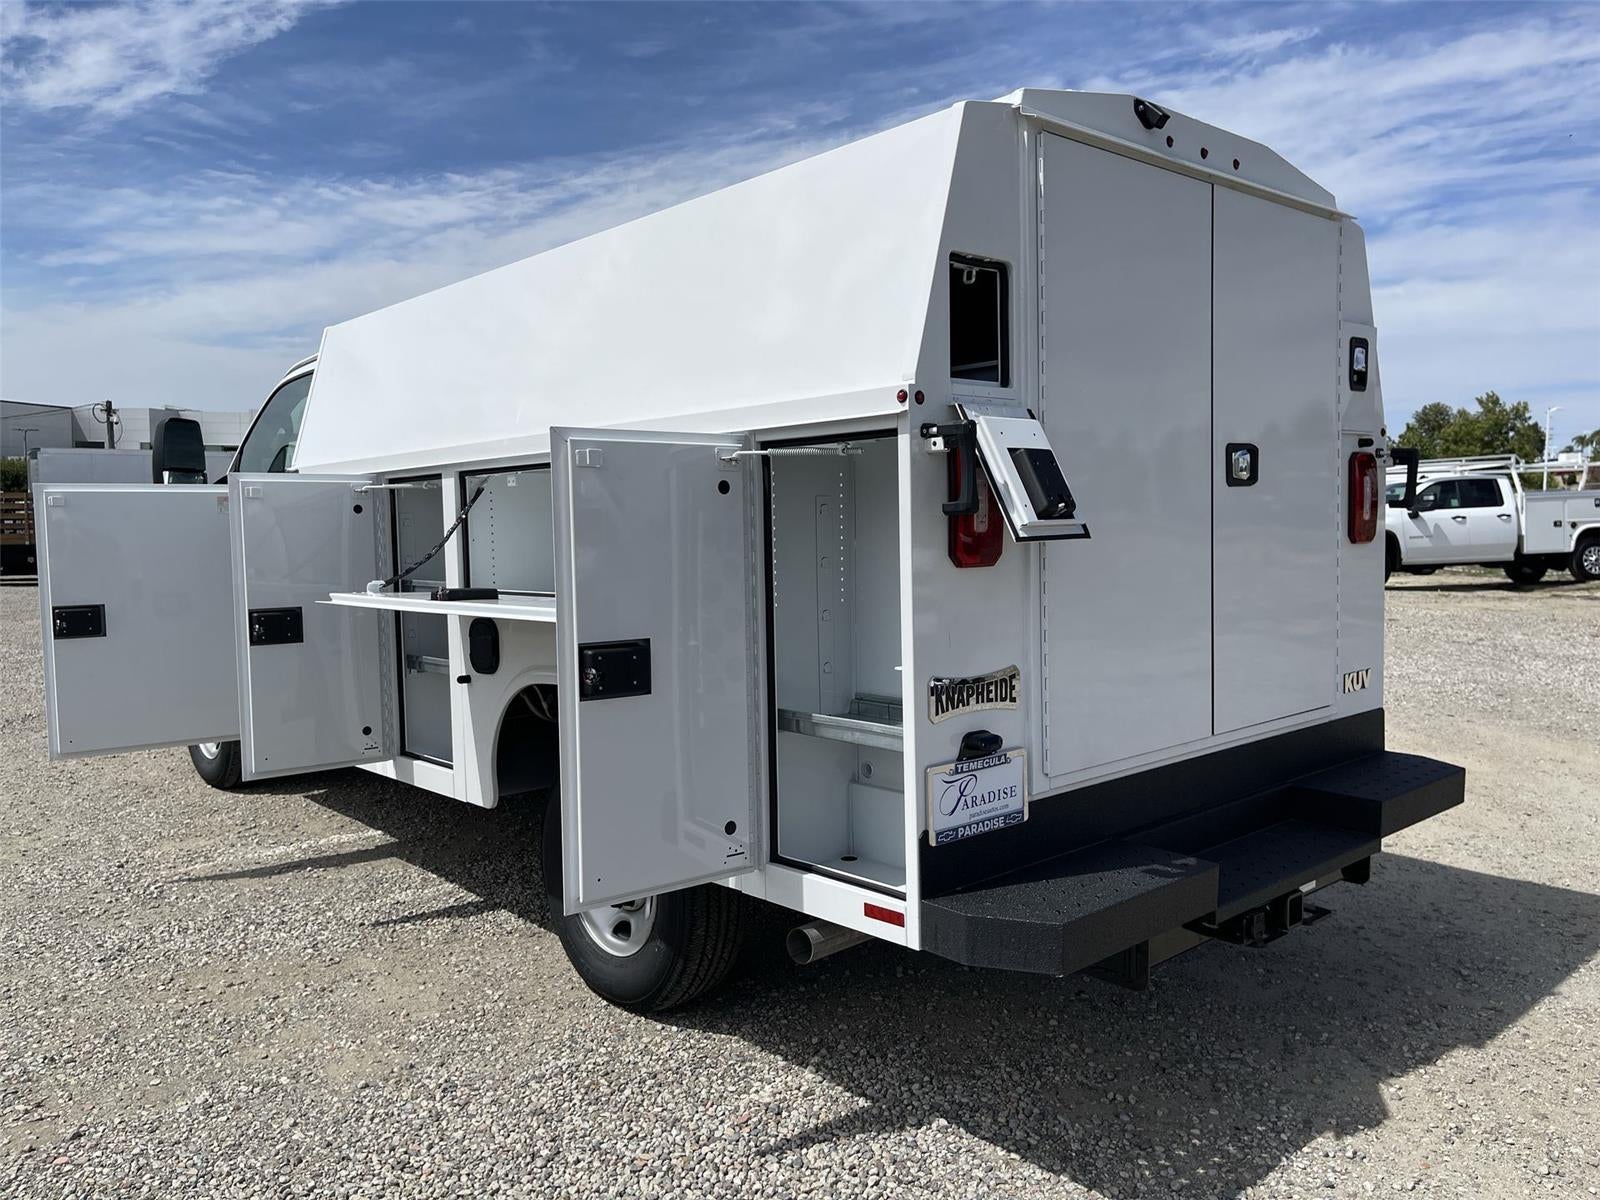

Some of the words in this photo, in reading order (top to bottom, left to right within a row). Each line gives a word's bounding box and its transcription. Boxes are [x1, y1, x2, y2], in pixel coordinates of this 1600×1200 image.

[1343, 667, 1371, 694] KUV
[934, 674, 1017, 716] KNAPHEIDE
[956, 755, 1006, 773] TEMECULA
[958, 816, 1005, 838] PARADISE
